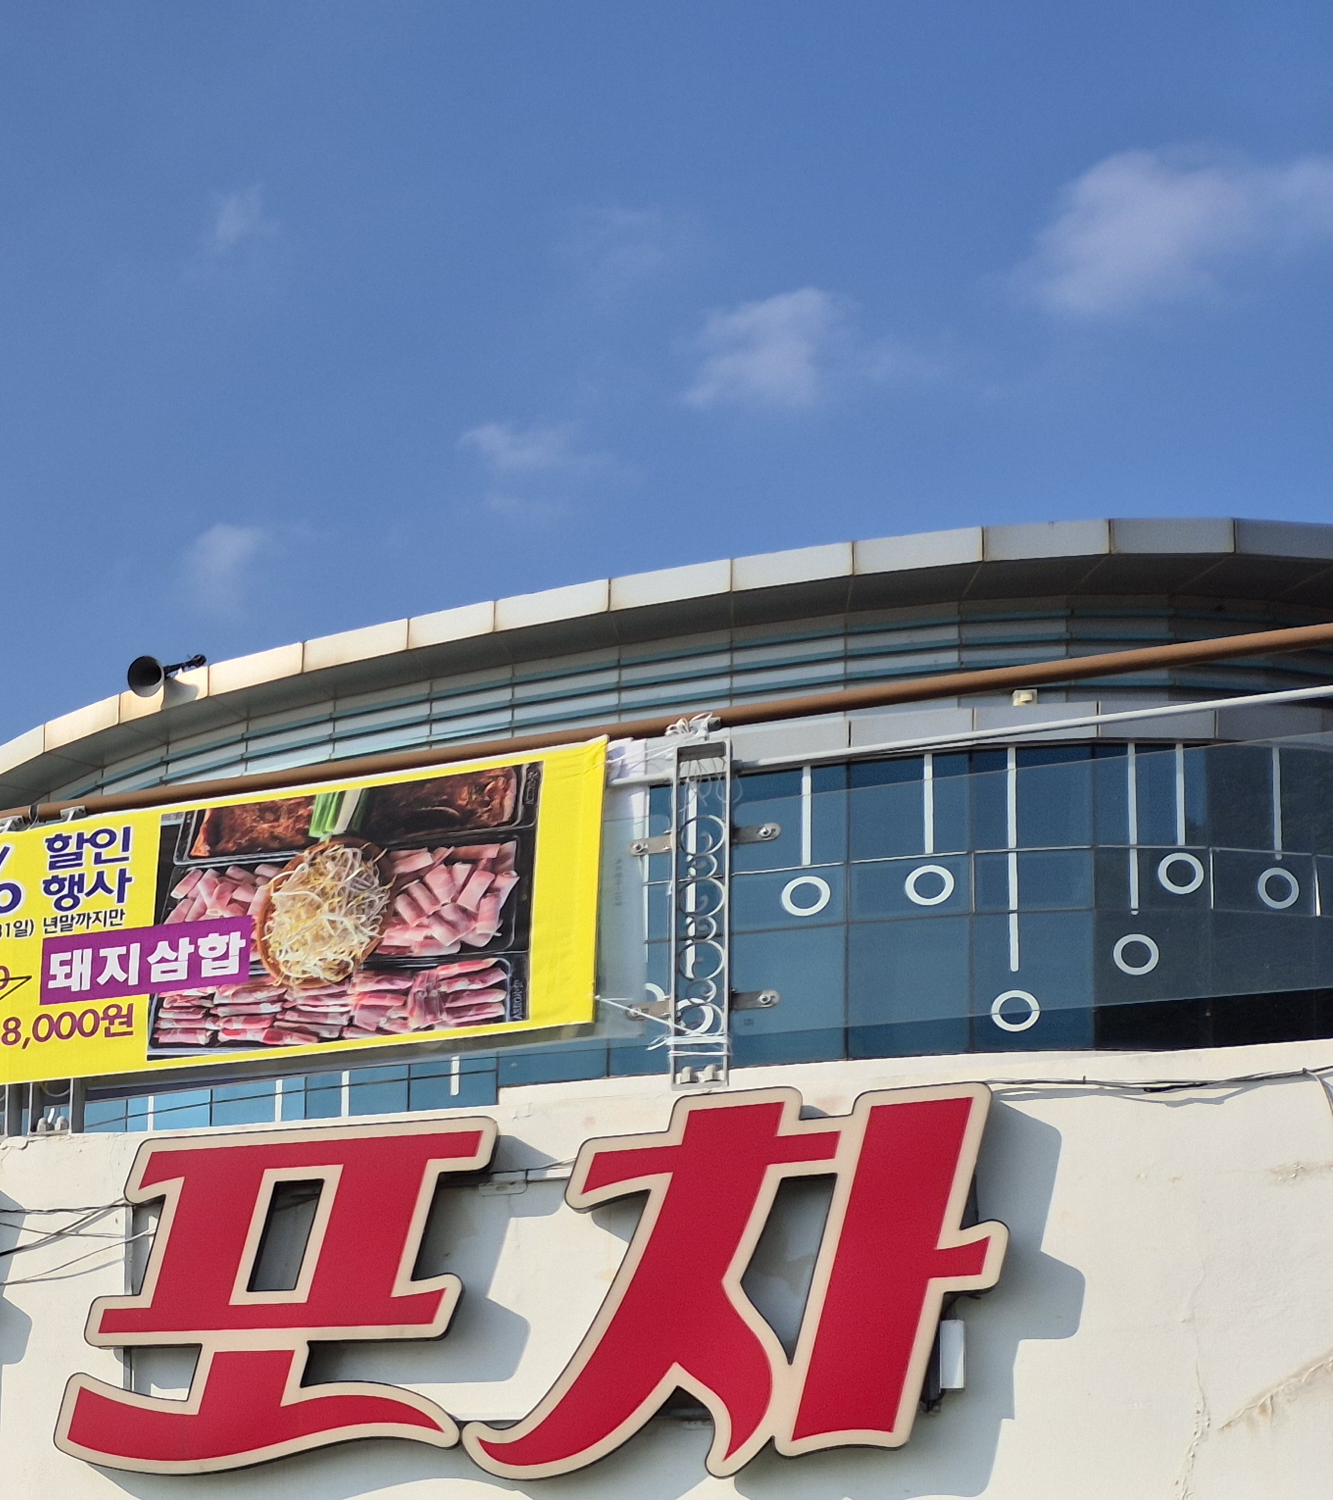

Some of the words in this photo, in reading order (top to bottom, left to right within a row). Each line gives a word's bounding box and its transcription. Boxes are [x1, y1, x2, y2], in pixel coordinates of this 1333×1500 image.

[44, 826, 132, 870] 할인
[42, 868, 133, 913] 행사
[42, 908, 125, 935] 년말까지만
[48, 929, 246, 993] 돼지삼합
[52, 1082, 1011, 1481] 포차
